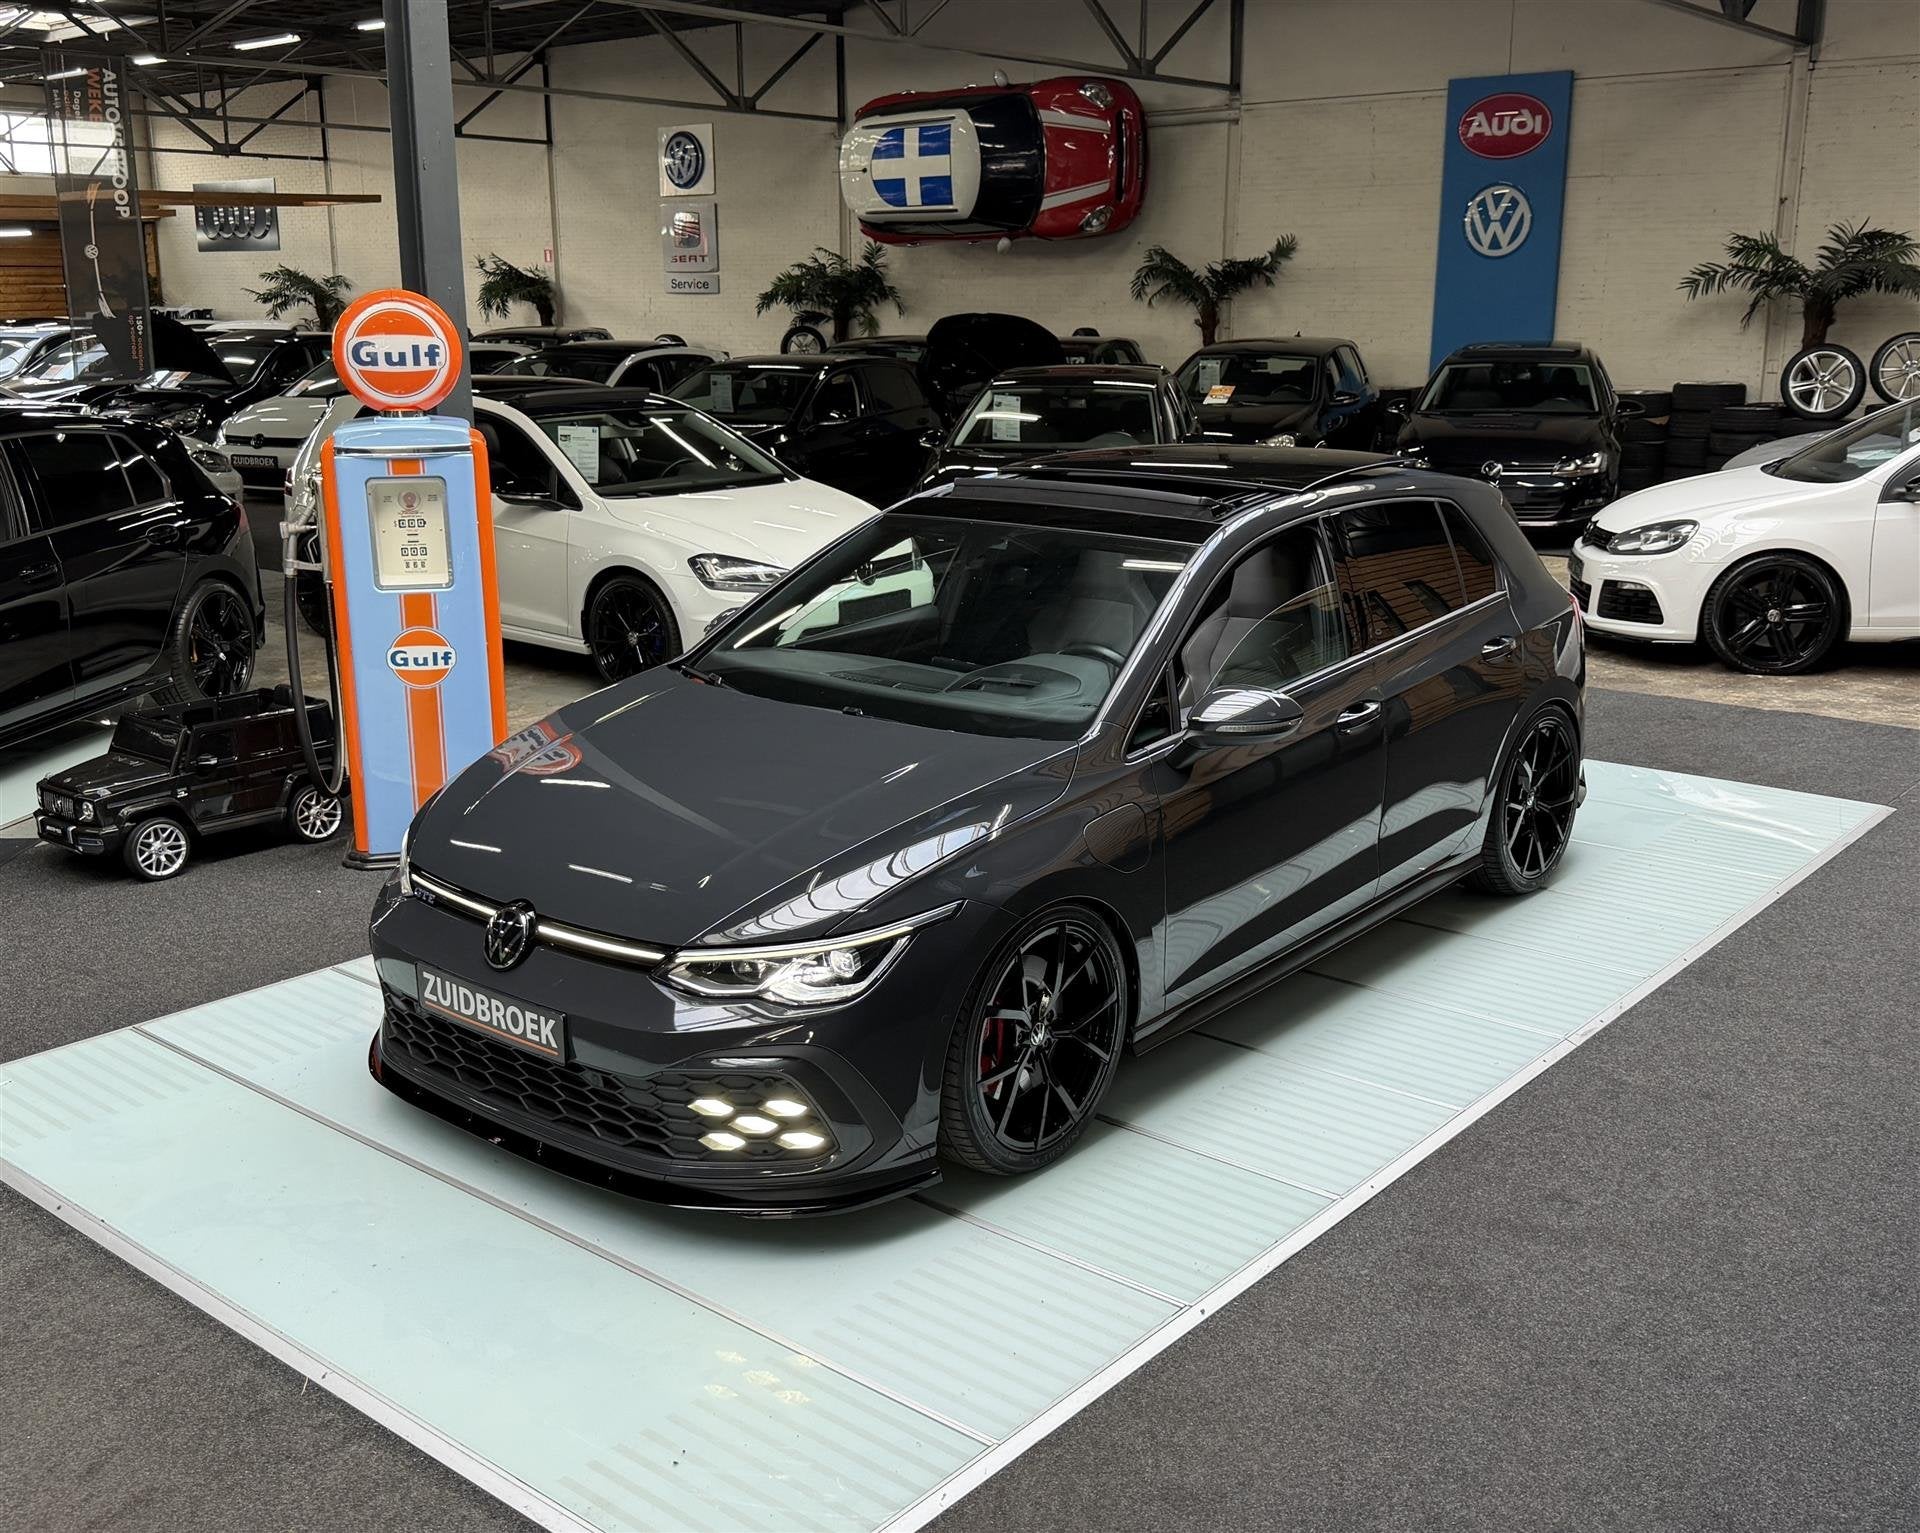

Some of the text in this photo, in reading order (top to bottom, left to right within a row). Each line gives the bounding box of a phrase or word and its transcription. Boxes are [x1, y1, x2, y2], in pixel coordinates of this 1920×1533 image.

[1467, 108, 1542, 138] Audi
[671, 255, 707, 263] SEAT
[671, 278, 709, 290] Service
[351, 341, 440, 367] Gulf
[232, 455, 274, 466] ZUIDBROEK
[390, 650, 452, 667] Gulf
[414, 887, 436, 904] GTE
[422, 971, 558, 1048] ZUIDBROEK
